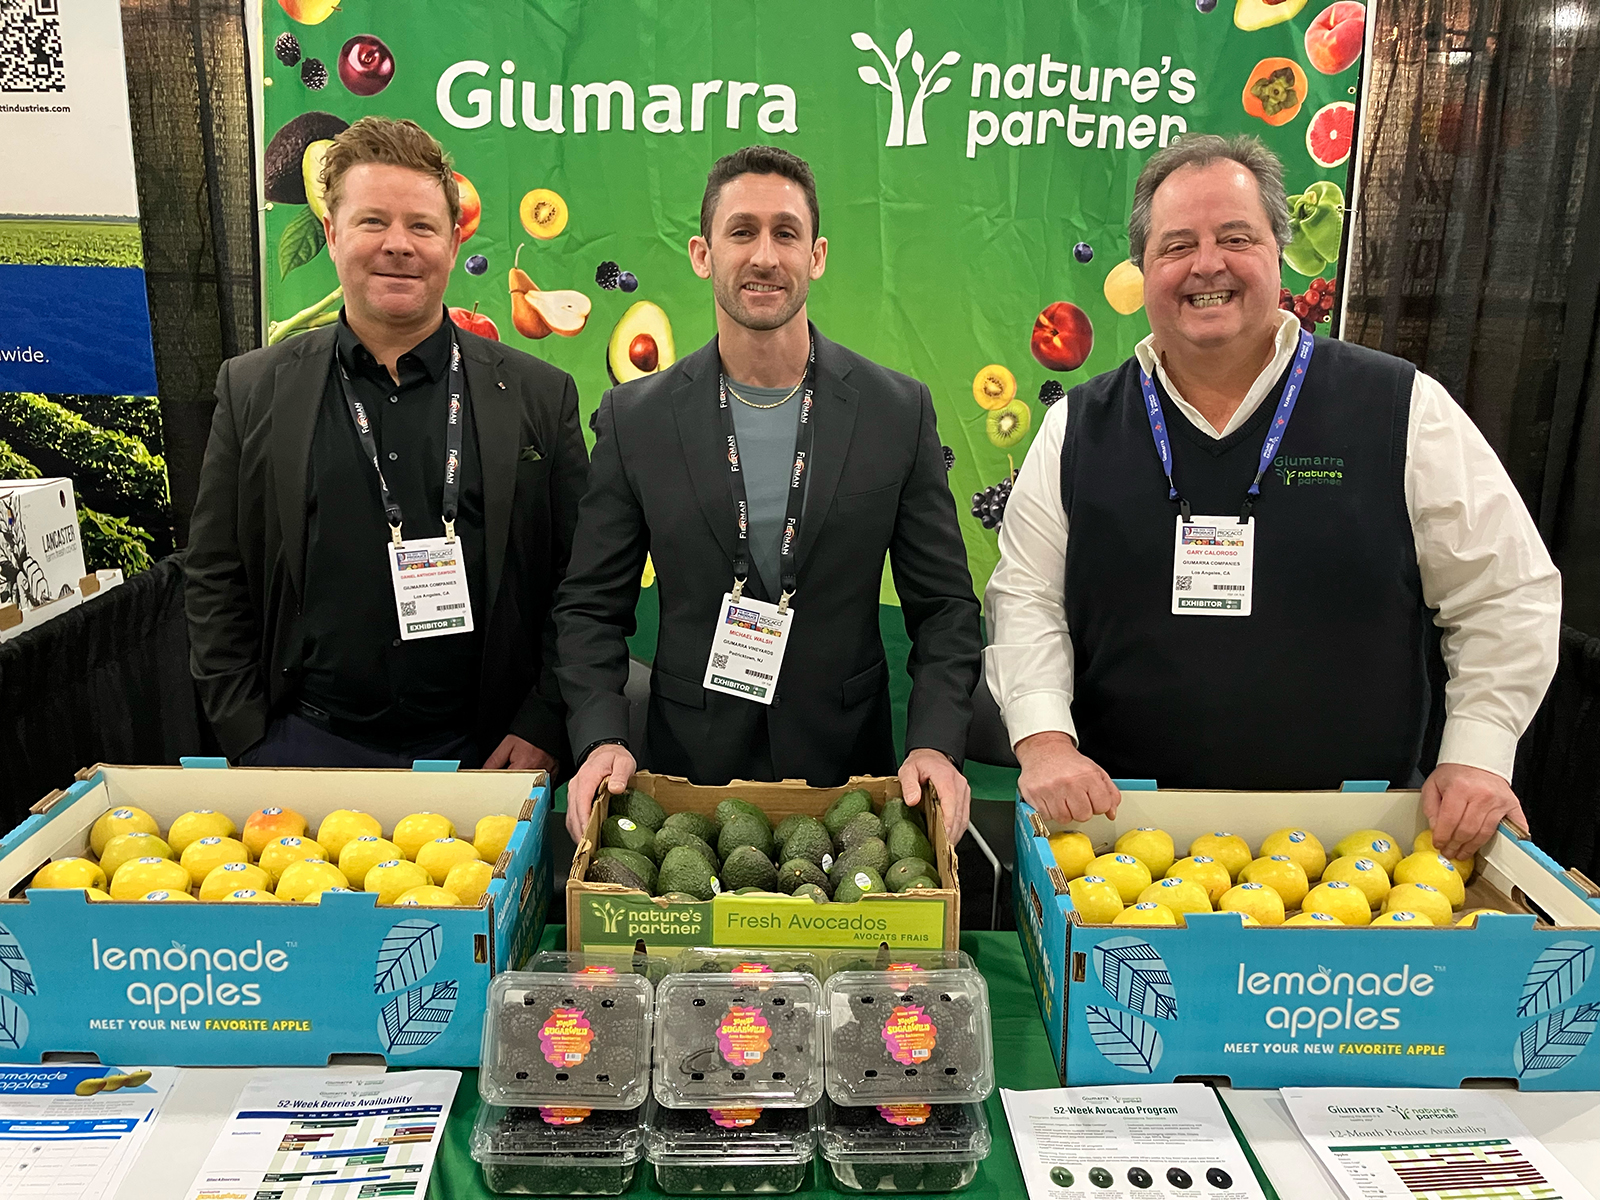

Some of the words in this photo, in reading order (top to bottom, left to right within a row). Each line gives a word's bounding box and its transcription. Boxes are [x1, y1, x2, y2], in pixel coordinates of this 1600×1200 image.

[970, 53, 1197, 104] nature's
[435, 60, 798, 134] Giumarra
[966, 103, 1188, 159] partner
[0, 345, 50, 363] wide.
[354, 402, 370, 434] FIERMAN
[450, 393, 460, 425] FIERMAN
[801, 388, 813, 424] FIERMAN
[446, 449, 458, 484] FIERMAN
[727, 434, 740, 472] FIERMAN
[1273, 456, 1344, 467] Giumarra
[792, 451, 806, 488] FIERMAN
[738, 500, 747, 540] FIERMAN
[42, 524, 76, 552] LANCASTER
[781, 518, 796, 556] FIERMAN
[410, 620, 448, 632] EXHIBITOR
[729, 630, 752, 640] MICHAEL
[754, 636, 774, 645] WALSH
[722, 638, 748, 648] GIUMARRA
[748, 646, 774, 656] VINEYARDS
[714, 677, 750, 692] EXHIBITOR
[628, 909, 702, 922] nature's
[628, 922, 701, 937] partner
[727, 912, 782, 928] Fresh
[788, 914, 888, 930] Avocados
[853, 932, 897, 941] AVOCATS
[900, 934, 929, 942] FRAIS
[92, 938, 289, 972] lemonade
[1237, 962, 1434, 997] lemonade
[126, 973, 262, 1015] apples
[89, 1019, 125, 1030] MEET
[128, 1019, 166, 1030] YOUR
[170, 1020, 201, 1030] NEW
[272, 1020, 311, 1031] APPLE
[1265, 998, 1400, 1038] apples
[1223, 1043, 1259, 1054] MEET
[1262, 1043, 1299, 1054] YOUR
[1304, 1044, 1334, 1054] NEW
[1406, 1044, 1446, 1055] APPLE
[277, 1100, 319, 1108] 52-Week
[320, 1100, 356, 1108] Berries
[357, 1095, 413, 1107] Availability
[1053, 1106, 1094, 1114] 52-Week
[1095, 1106, 1135, 1114] Avocado
[1136, 1106, 1178, 1116] Program
[1330, 1129, 1384, 1137] 12-Month
[1385, 1128, 1428, 1137] Product
[1430, 1125, 1487, 1134] Availability
